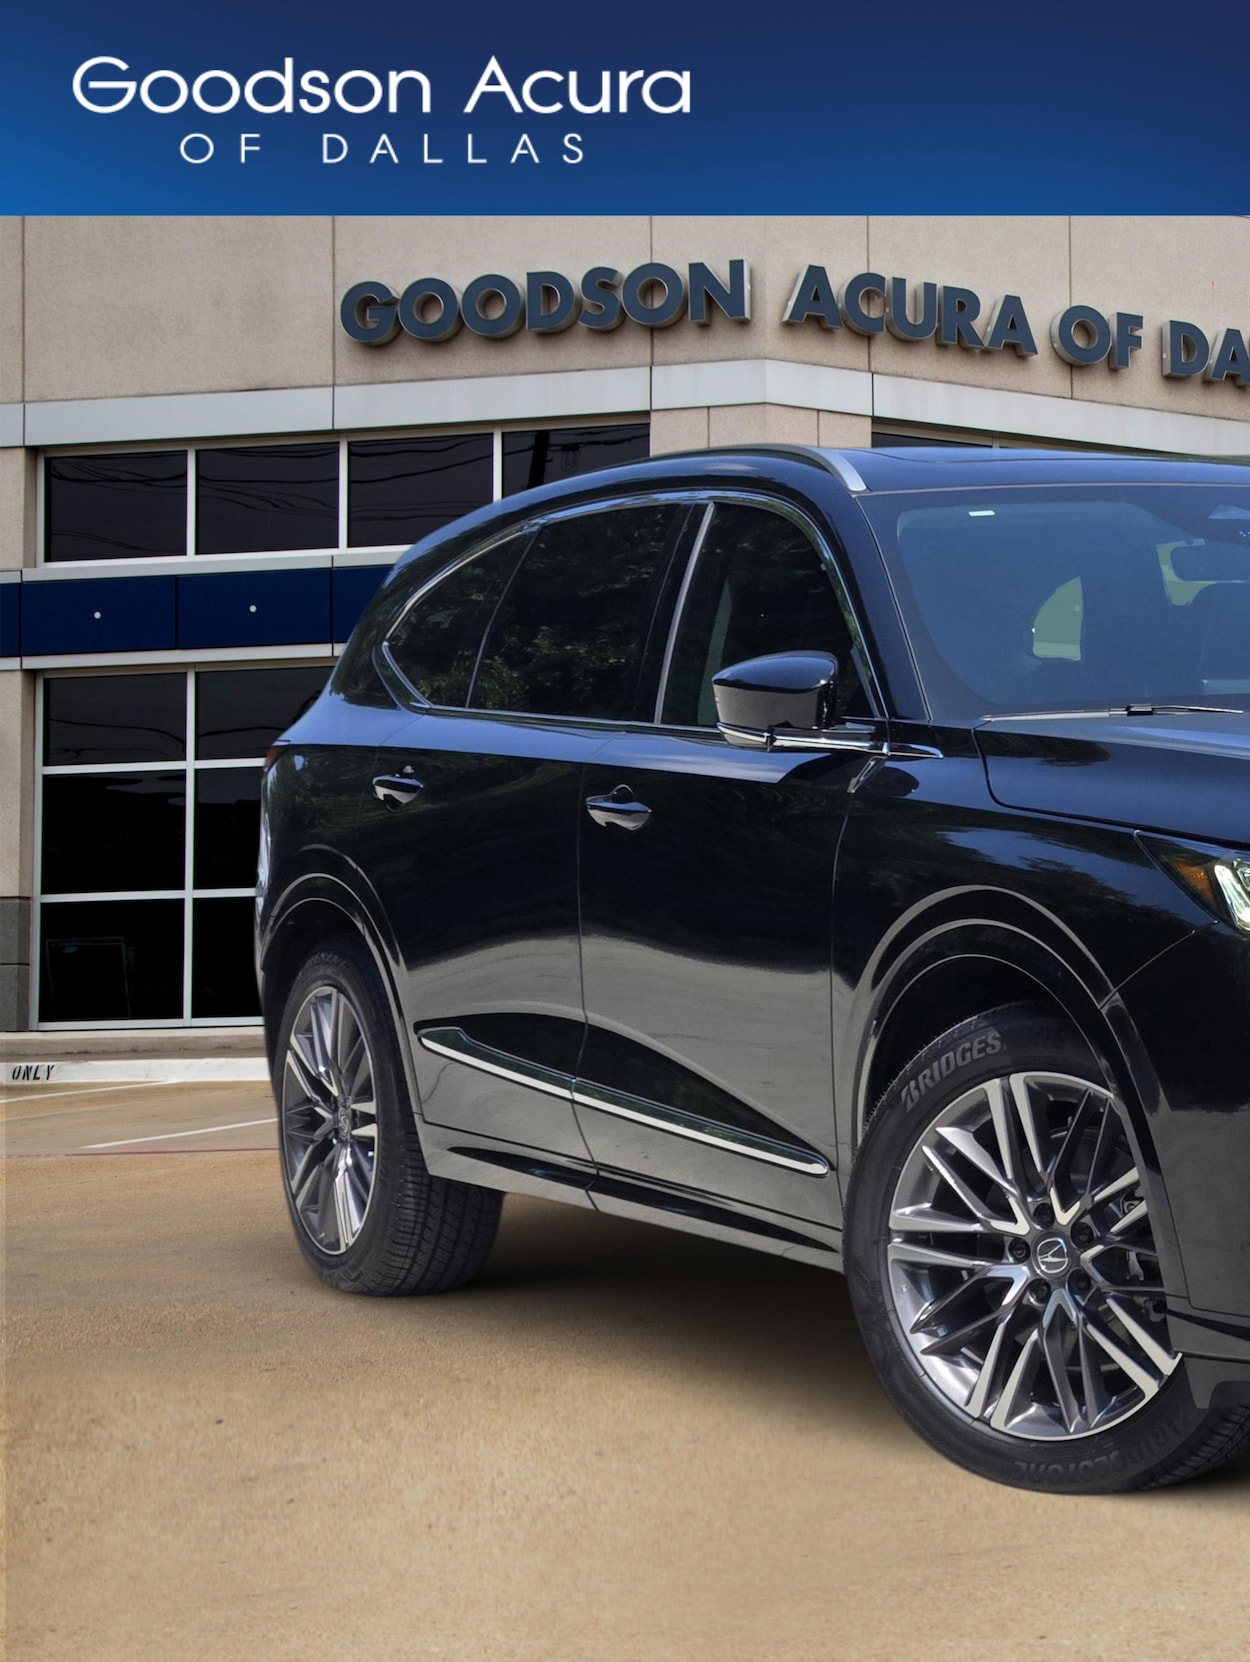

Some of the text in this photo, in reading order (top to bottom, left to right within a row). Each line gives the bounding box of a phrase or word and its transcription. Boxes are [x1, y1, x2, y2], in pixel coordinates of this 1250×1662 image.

[340, 259, 751, 344] GOODSON
[782, 264, 1038, 355] ACURA
[1051, 304, 1144, 369] OF
[12, 1064, 55, 1081] ONLY
[900, 1032, 1006, 1112] BRIDGES
